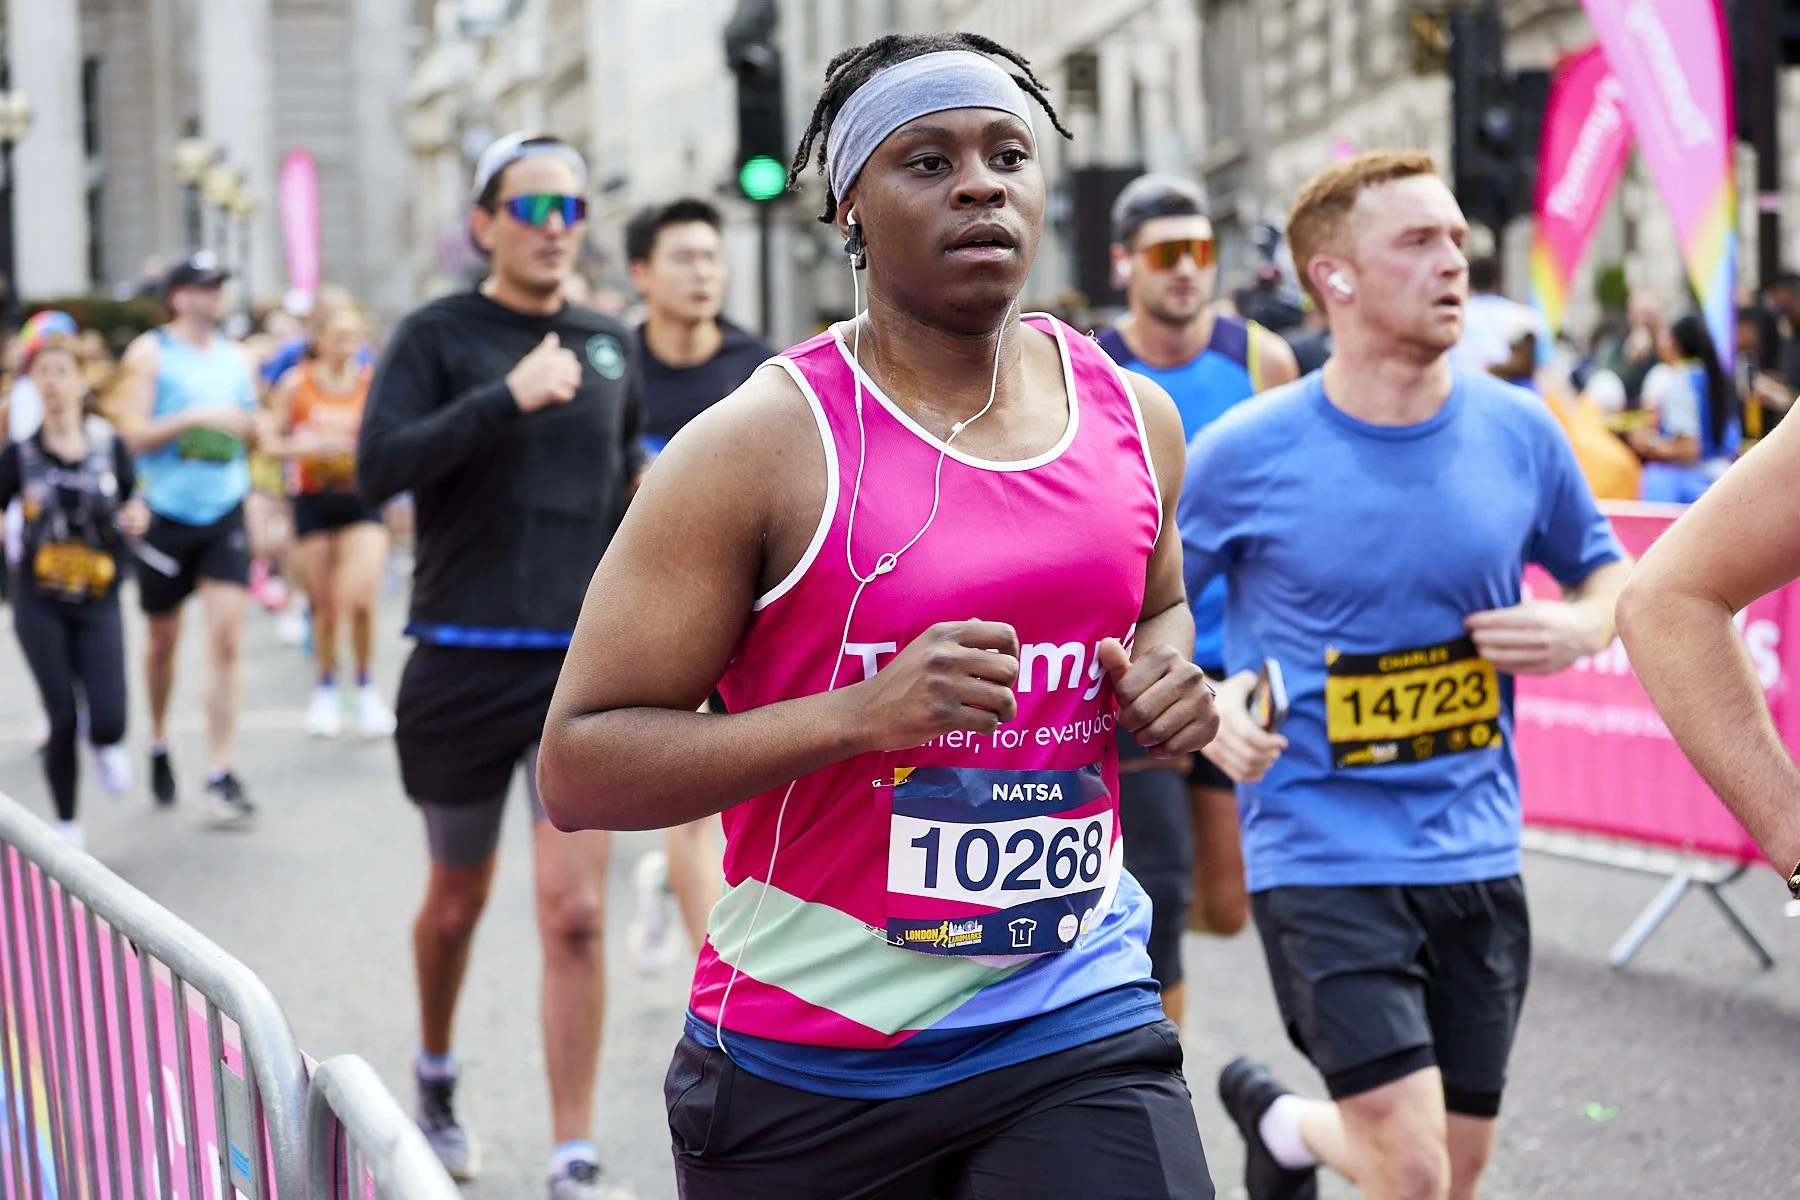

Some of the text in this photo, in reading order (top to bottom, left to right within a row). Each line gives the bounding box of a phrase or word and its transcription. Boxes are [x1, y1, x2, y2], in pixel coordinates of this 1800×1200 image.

[1378, 646, 1449, 671] CHARLES
[1342, 670, 1488, 726] 14723
[992, 722, 1029, 748] for
[992, 783, 1063, 802] NATSA
[910, 820, 1103, 892] 10268
[905, 928, 938, 941] LONDON
